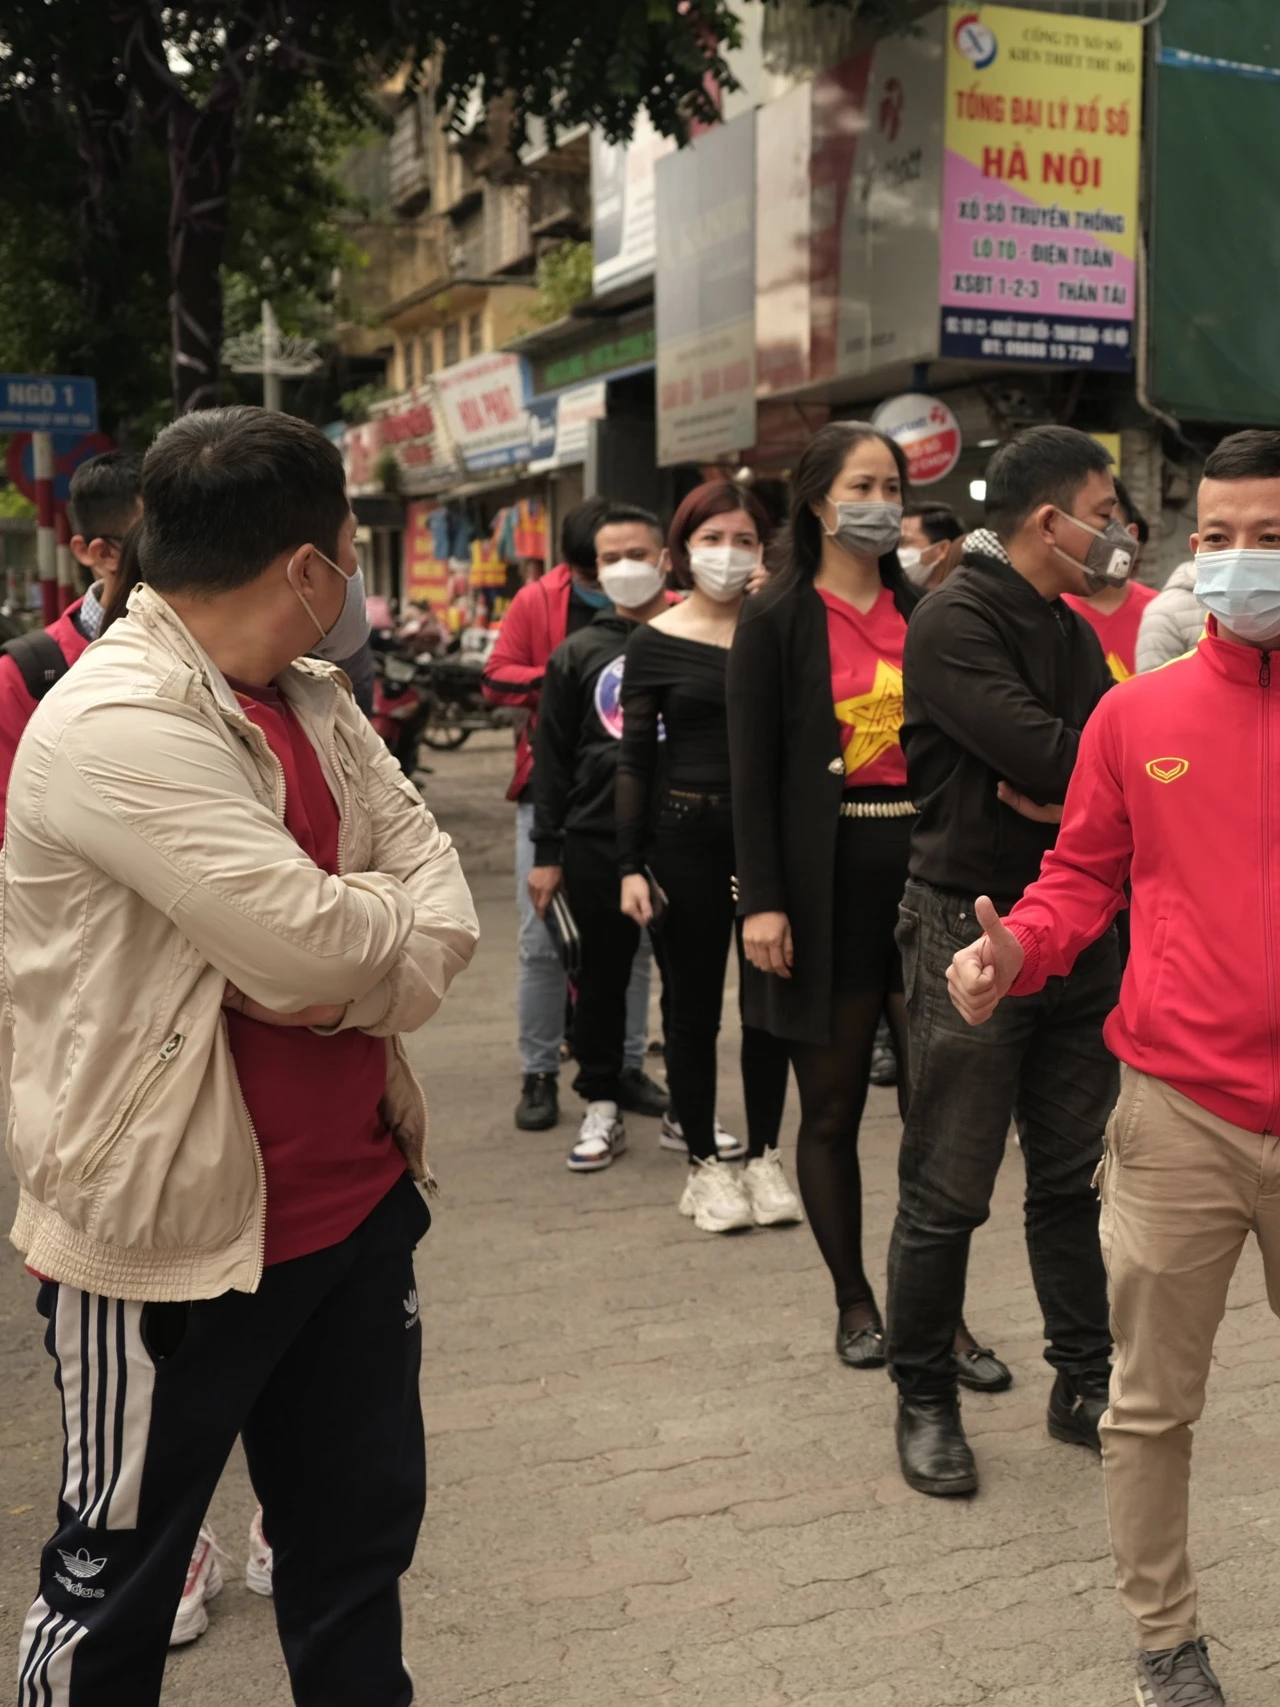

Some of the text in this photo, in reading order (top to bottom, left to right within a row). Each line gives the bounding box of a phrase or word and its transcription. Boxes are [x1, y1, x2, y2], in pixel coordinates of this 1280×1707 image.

[1010, 96, 1042, 133] ĐẠI
[982, 141, 1103, 195] HÀ NỘI
[63, 384, 74, 407] 1
